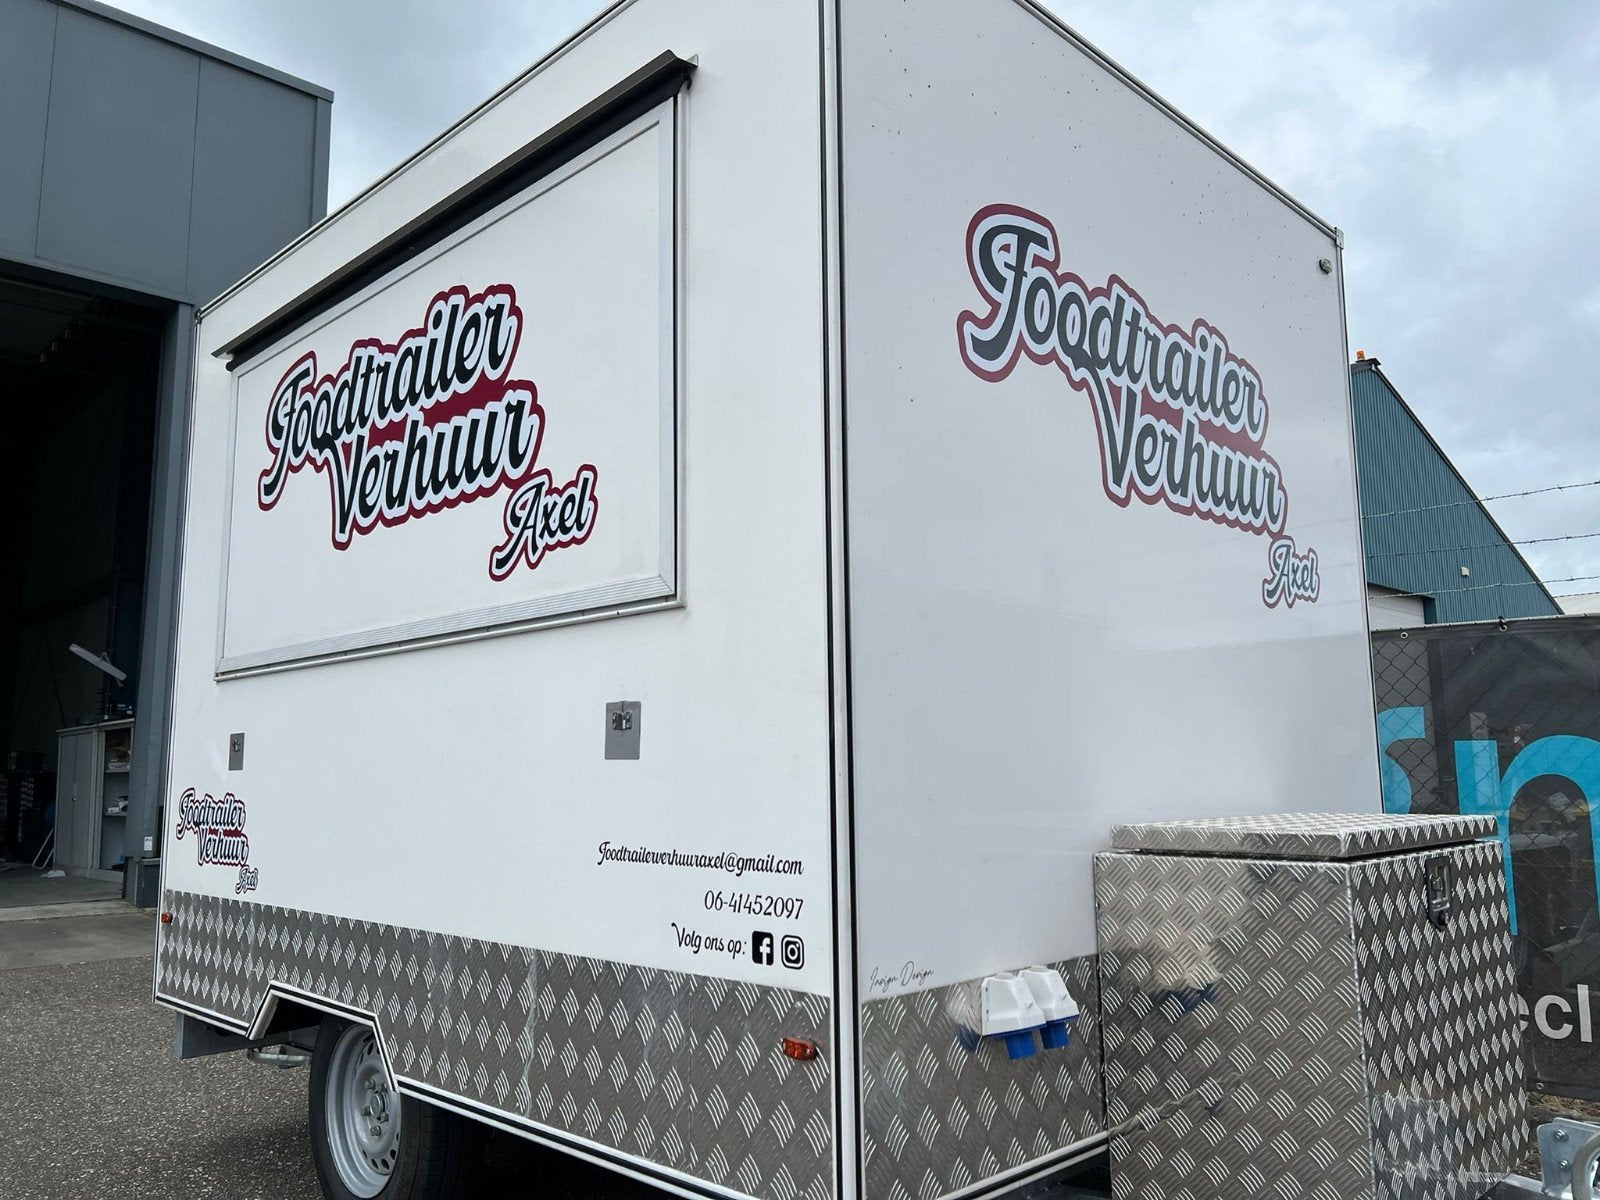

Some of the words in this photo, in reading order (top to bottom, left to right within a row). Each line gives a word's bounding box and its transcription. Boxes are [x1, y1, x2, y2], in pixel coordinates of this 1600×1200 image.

[971, 224, 1263, 434] Foodtrailer
[262, 301, 515, 497] Foodtrailer
[328, 398, 535, 535] Verhuur
[1090, 370, 1284, 525] Verhuur
[495, 476, 590, 570] Axel
[1265, 543, 1317, 600] Axel
[177, 792, 244, 835] Foodtrailer
[198, 827, 248, 862] Verhuur
[671, 922, 701, 954] Volg
[704, 936, 725, 952] ons
[727, 939, 747, 960] op:
[704, 890, 803, 920] 06-41452097
